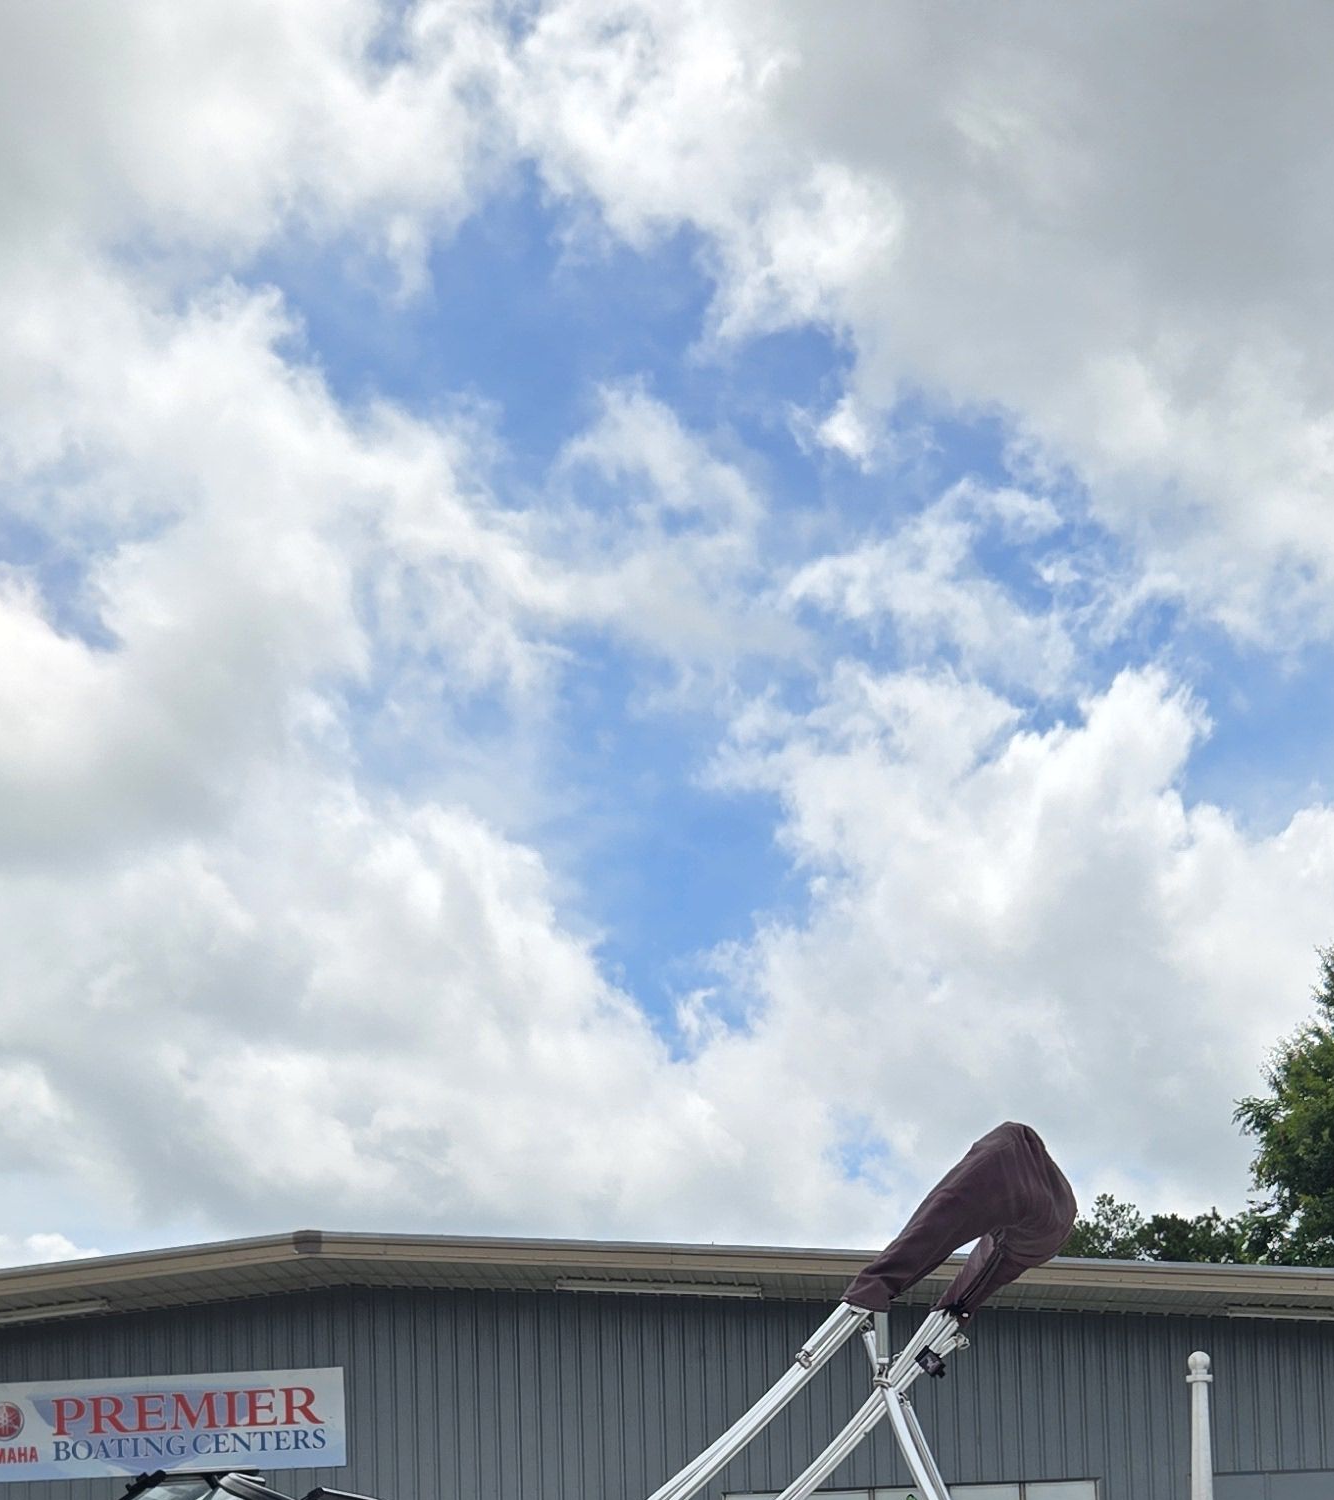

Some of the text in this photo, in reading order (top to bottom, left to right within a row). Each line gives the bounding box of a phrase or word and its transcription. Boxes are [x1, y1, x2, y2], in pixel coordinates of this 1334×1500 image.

[52, 1386, 325, 1436] PREMIER
[53, 1428, 326, 1461] BOATING CENTERS
